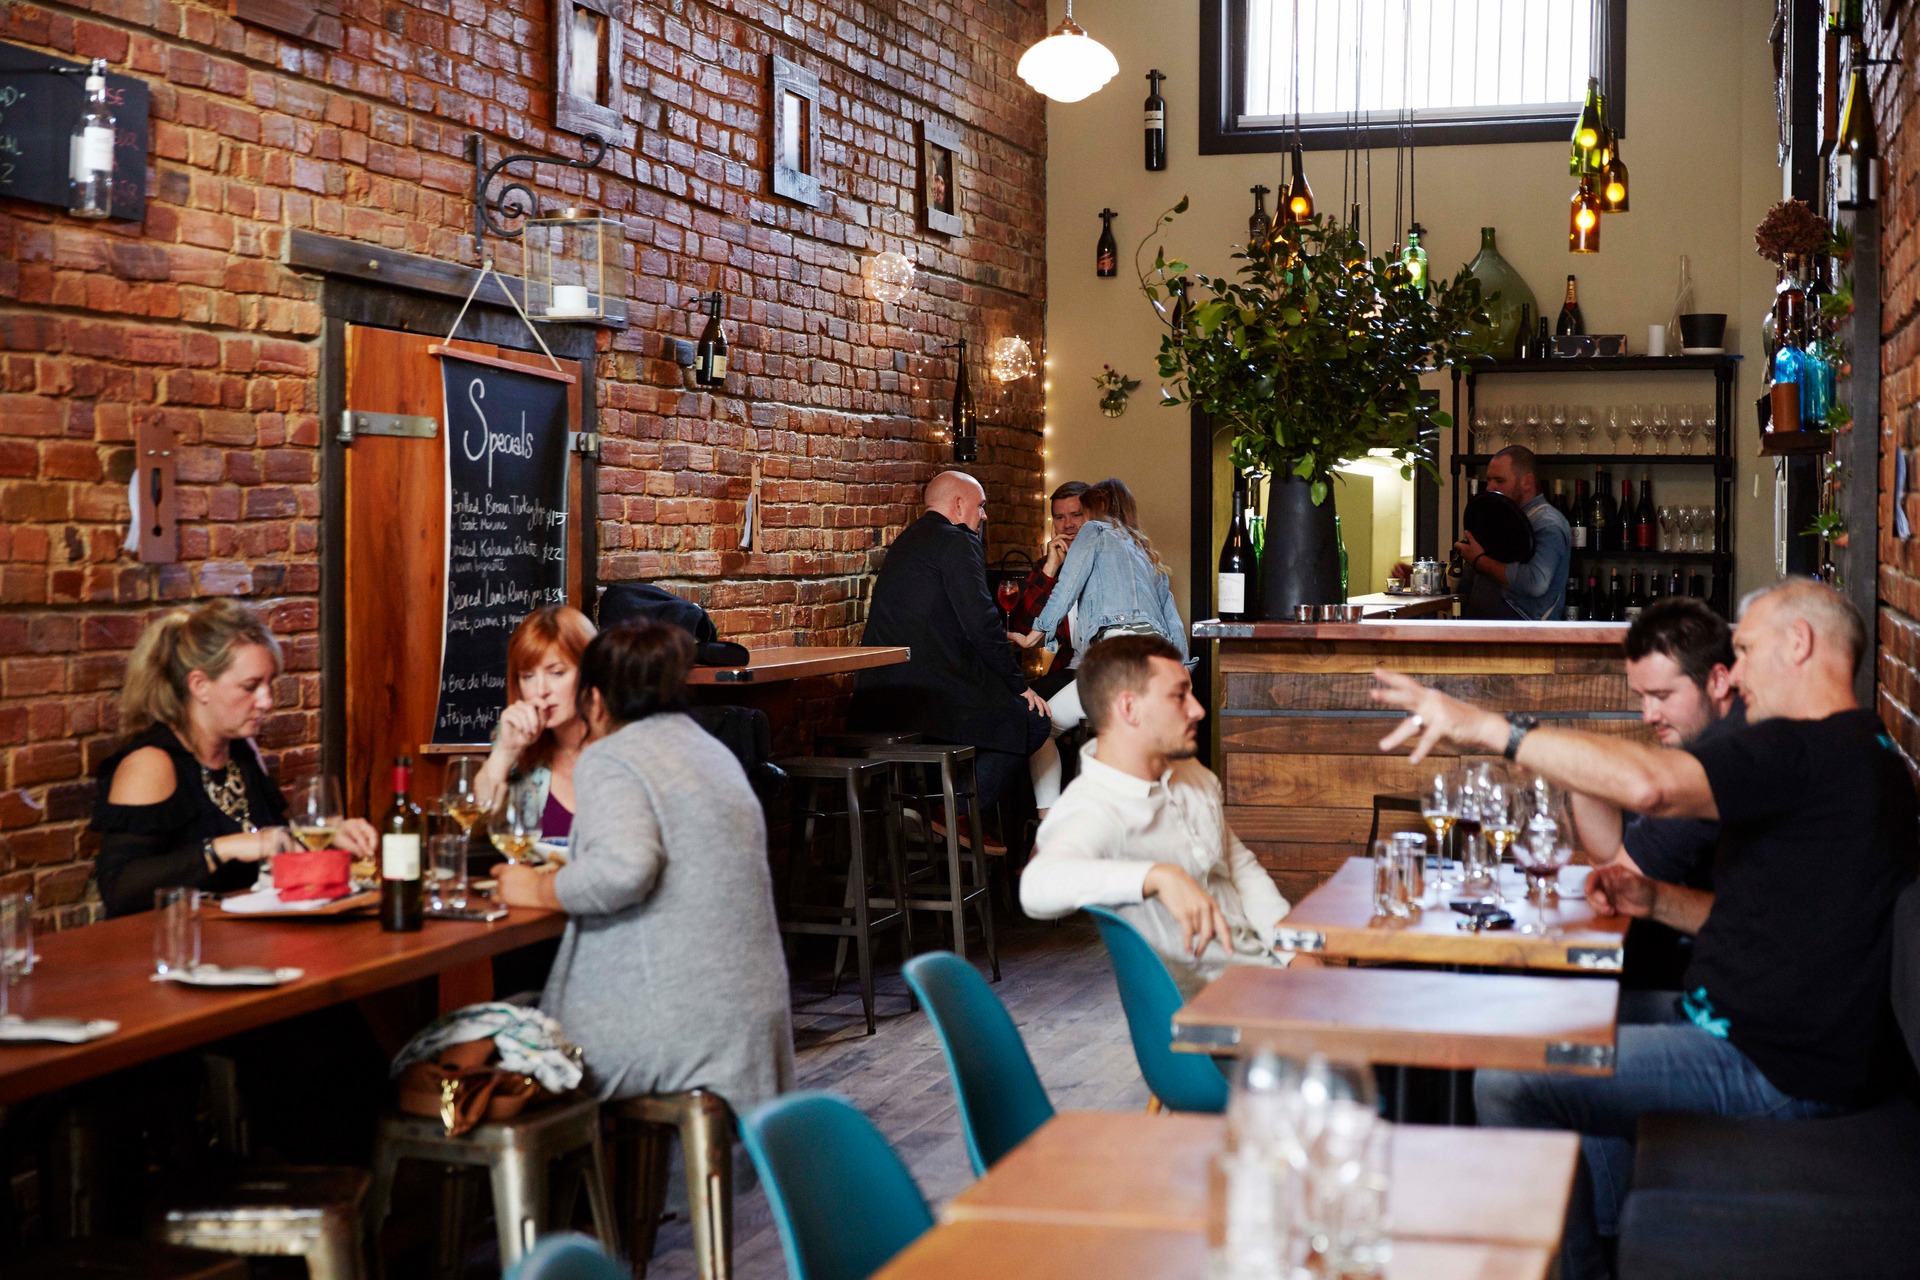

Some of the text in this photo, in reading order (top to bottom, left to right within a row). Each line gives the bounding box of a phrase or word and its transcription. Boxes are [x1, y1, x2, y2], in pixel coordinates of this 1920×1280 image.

[463, 378, 534, 488] Specials
[546, 509, 568, 531] $15
[484, 578, 506, 607] Lamb
[467, 673, 479, 690] de
